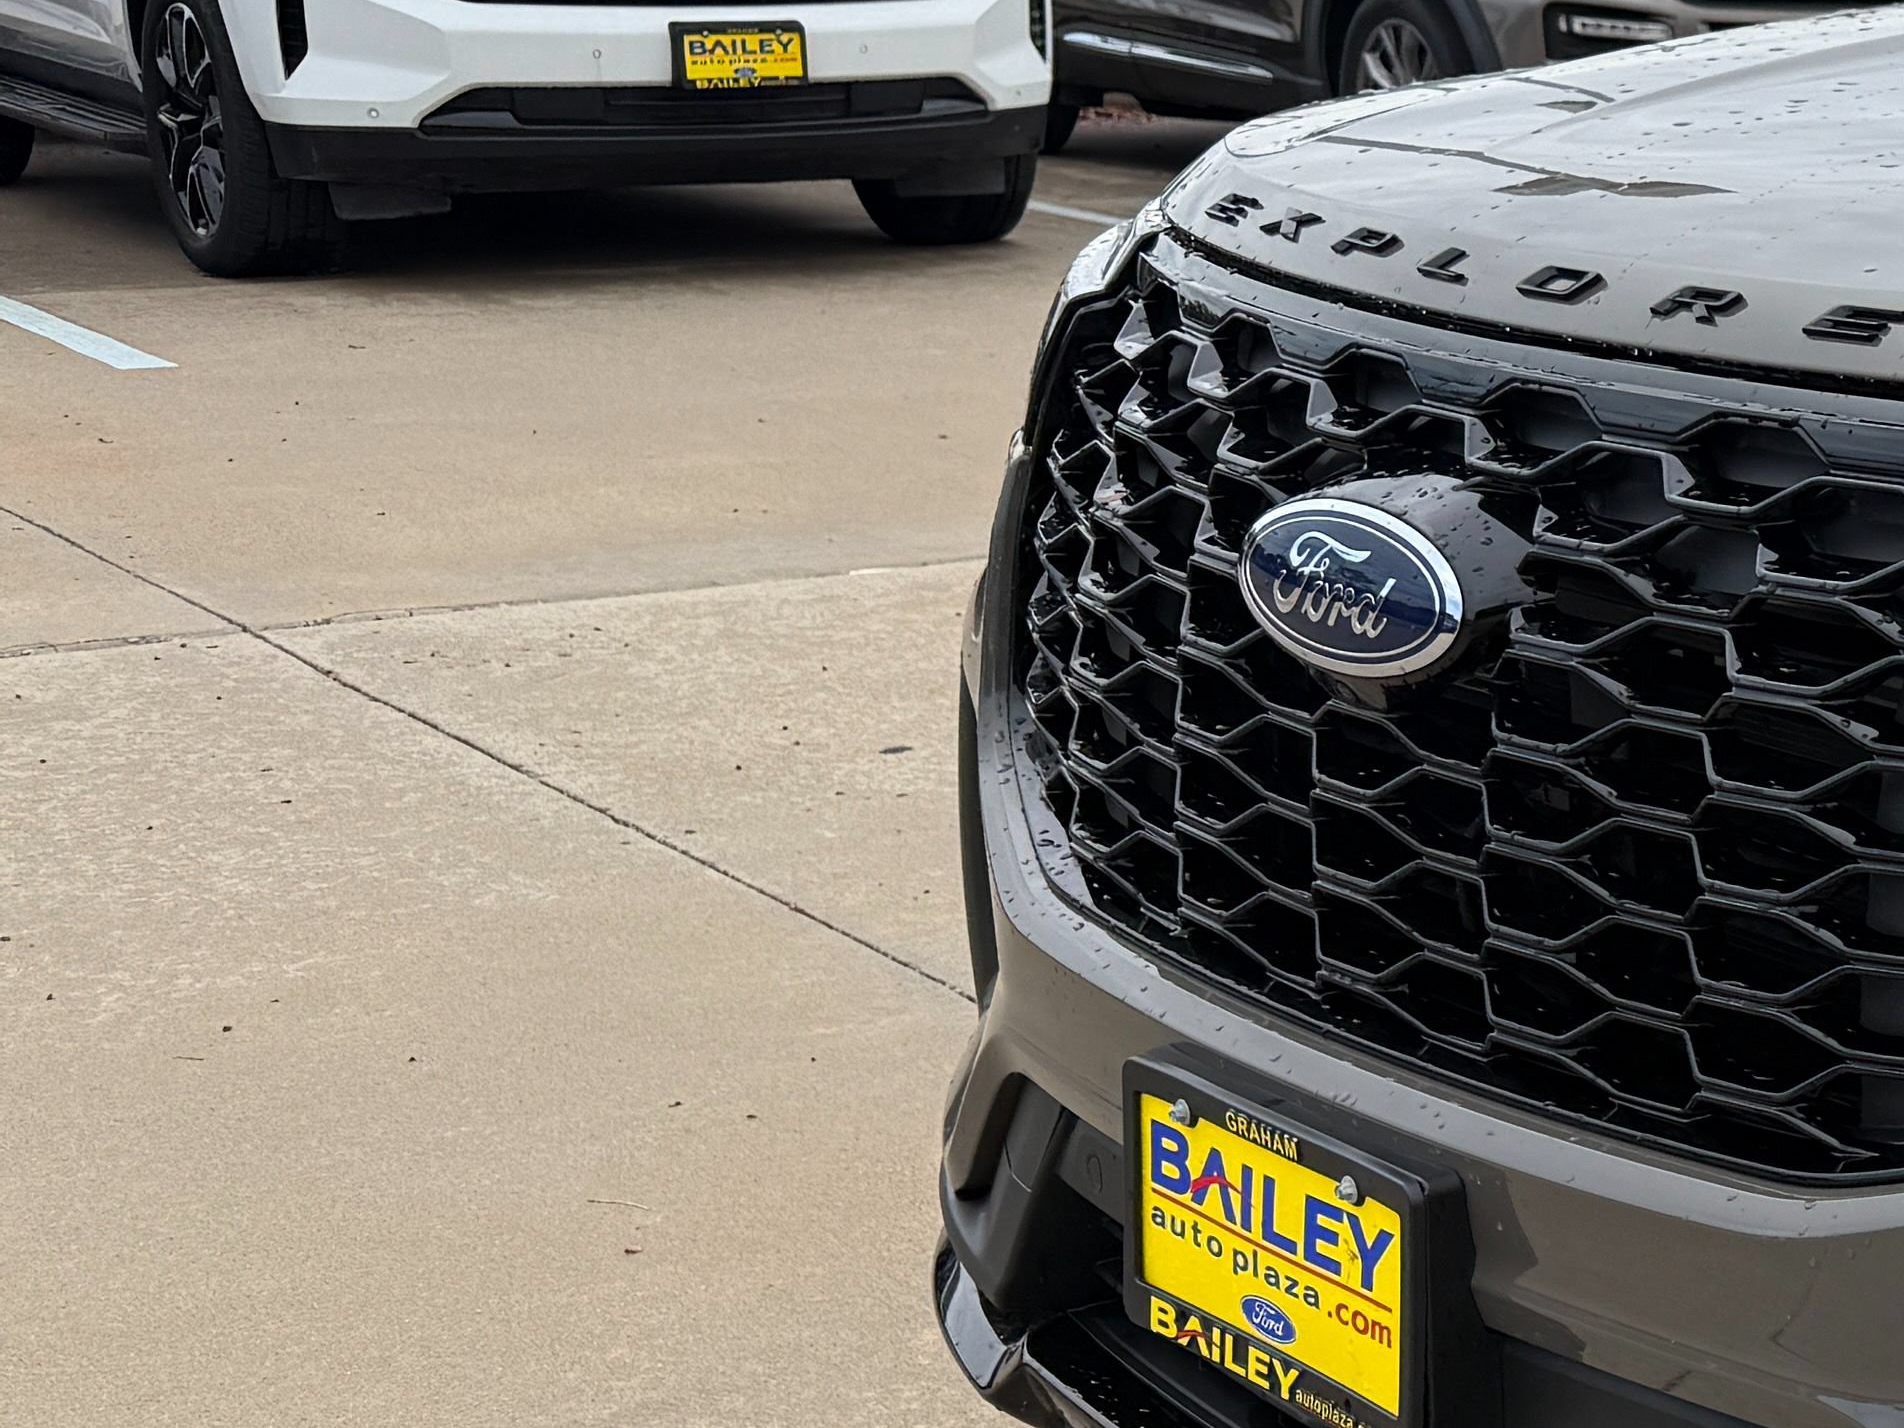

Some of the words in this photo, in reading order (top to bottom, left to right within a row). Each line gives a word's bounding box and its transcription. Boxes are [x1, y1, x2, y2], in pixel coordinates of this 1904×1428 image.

[689, 37, 794, 55] BAILEY
[1273, 531, 1397, 639] Ford
[1225, 1108, 1299, 1162] GRAHAM
[1150, 1118, 1395, 1293] BAILEY
[1151, 1204, 1223, 1259] auto
[1252, 1300, 1285, 1336] Ford
[1150, 1294, 1299, 1401] BAILEY
